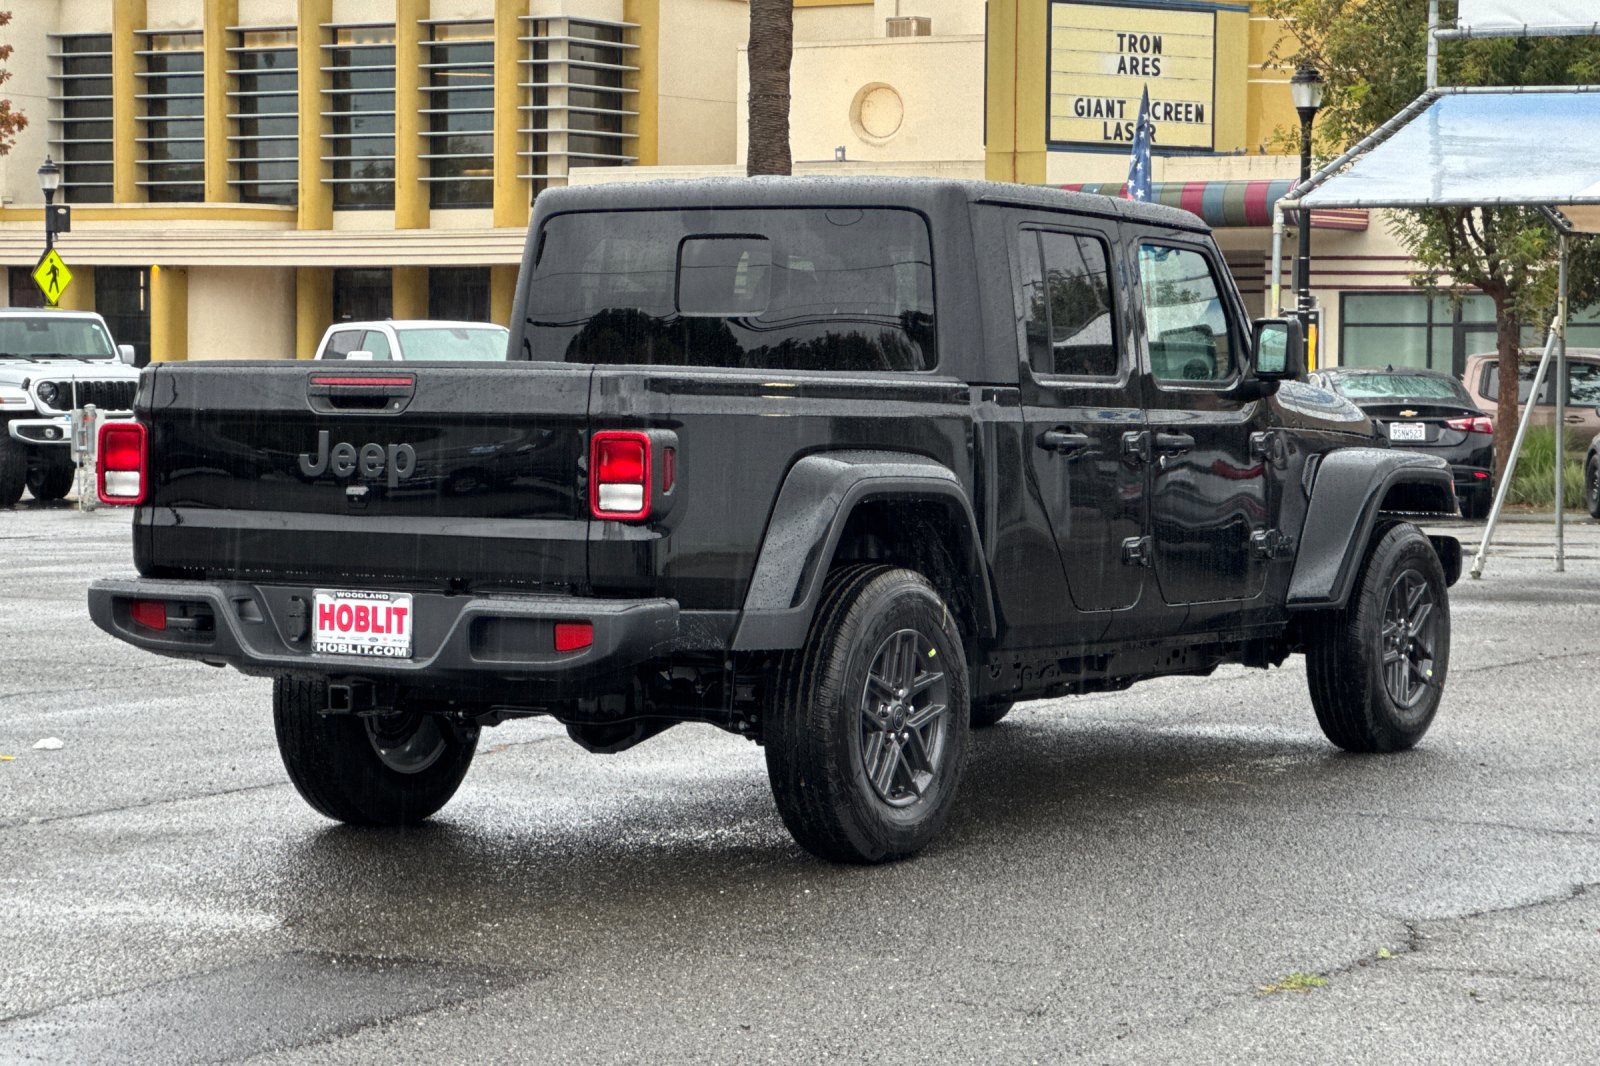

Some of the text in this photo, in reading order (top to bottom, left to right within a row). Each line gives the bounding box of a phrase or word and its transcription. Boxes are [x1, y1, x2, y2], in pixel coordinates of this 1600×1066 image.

[1117, 33, 1162, 54] TRON
[1117, 55, 1161, 77] ARES
[1074, 97, 1205, 123] GIANT CREEN
[1103, 121, 1156, 143] LASR
[298, 429, 416, 488] Jeep
[336, 591, 389, 600] WOODLAND
[318, 603, 408, 635] HOBLIT
[316, 642, 407, 657] HOBLIT.COM
